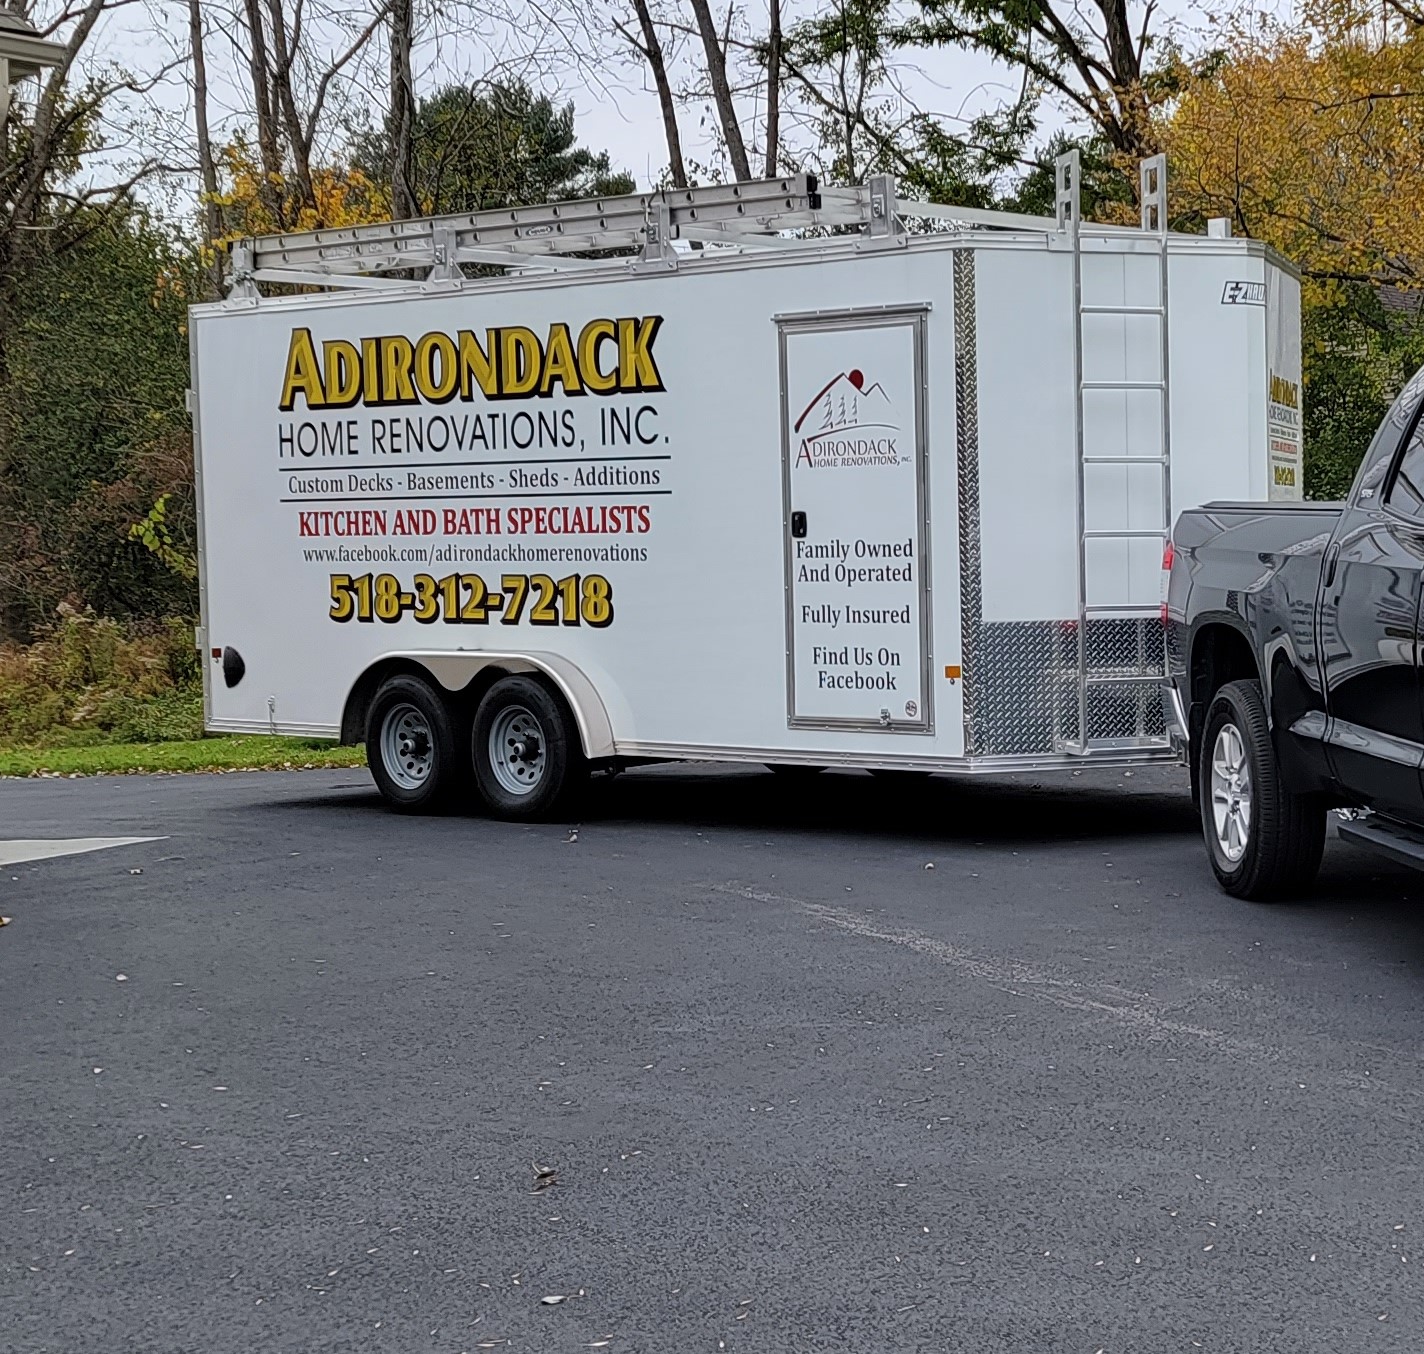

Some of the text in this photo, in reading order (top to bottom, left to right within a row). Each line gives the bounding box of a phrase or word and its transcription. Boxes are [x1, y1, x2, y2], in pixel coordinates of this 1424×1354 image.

[278, 315, 668, 412] ADIRONDACK
[279, 406, 669, 457] HOME RENOVATIONS, INC.
[795, 439, 897, 468] ADIRONDACK
[814, 459, 838, 468] HOME
[841, 456, 900, 466] RENOVATIONS,
[288, 475, 344, 494] Custom
[348, 473, 393, 492] Decks
[407, 471, 494, 491] Basements
[509, 468, 559, 488] Sheds
[573, 466, 660, 486] Additions
[299, 505, 651, 537] KITCHEN AND BATH SPECIALISTS
[303, 544, 648, 566] www.facebook.com/adirondackhomerenovations
[797, 539, 913, 563] Family Owned
[798, 563, 912, 587] And Operated
[329, 572, 614, 628] 518-312-7218
[802, 605, 910, 628] Fully Insured
[813, 647, 901, 666] Find Us On
[818, 671, 897, 691] Facebook
